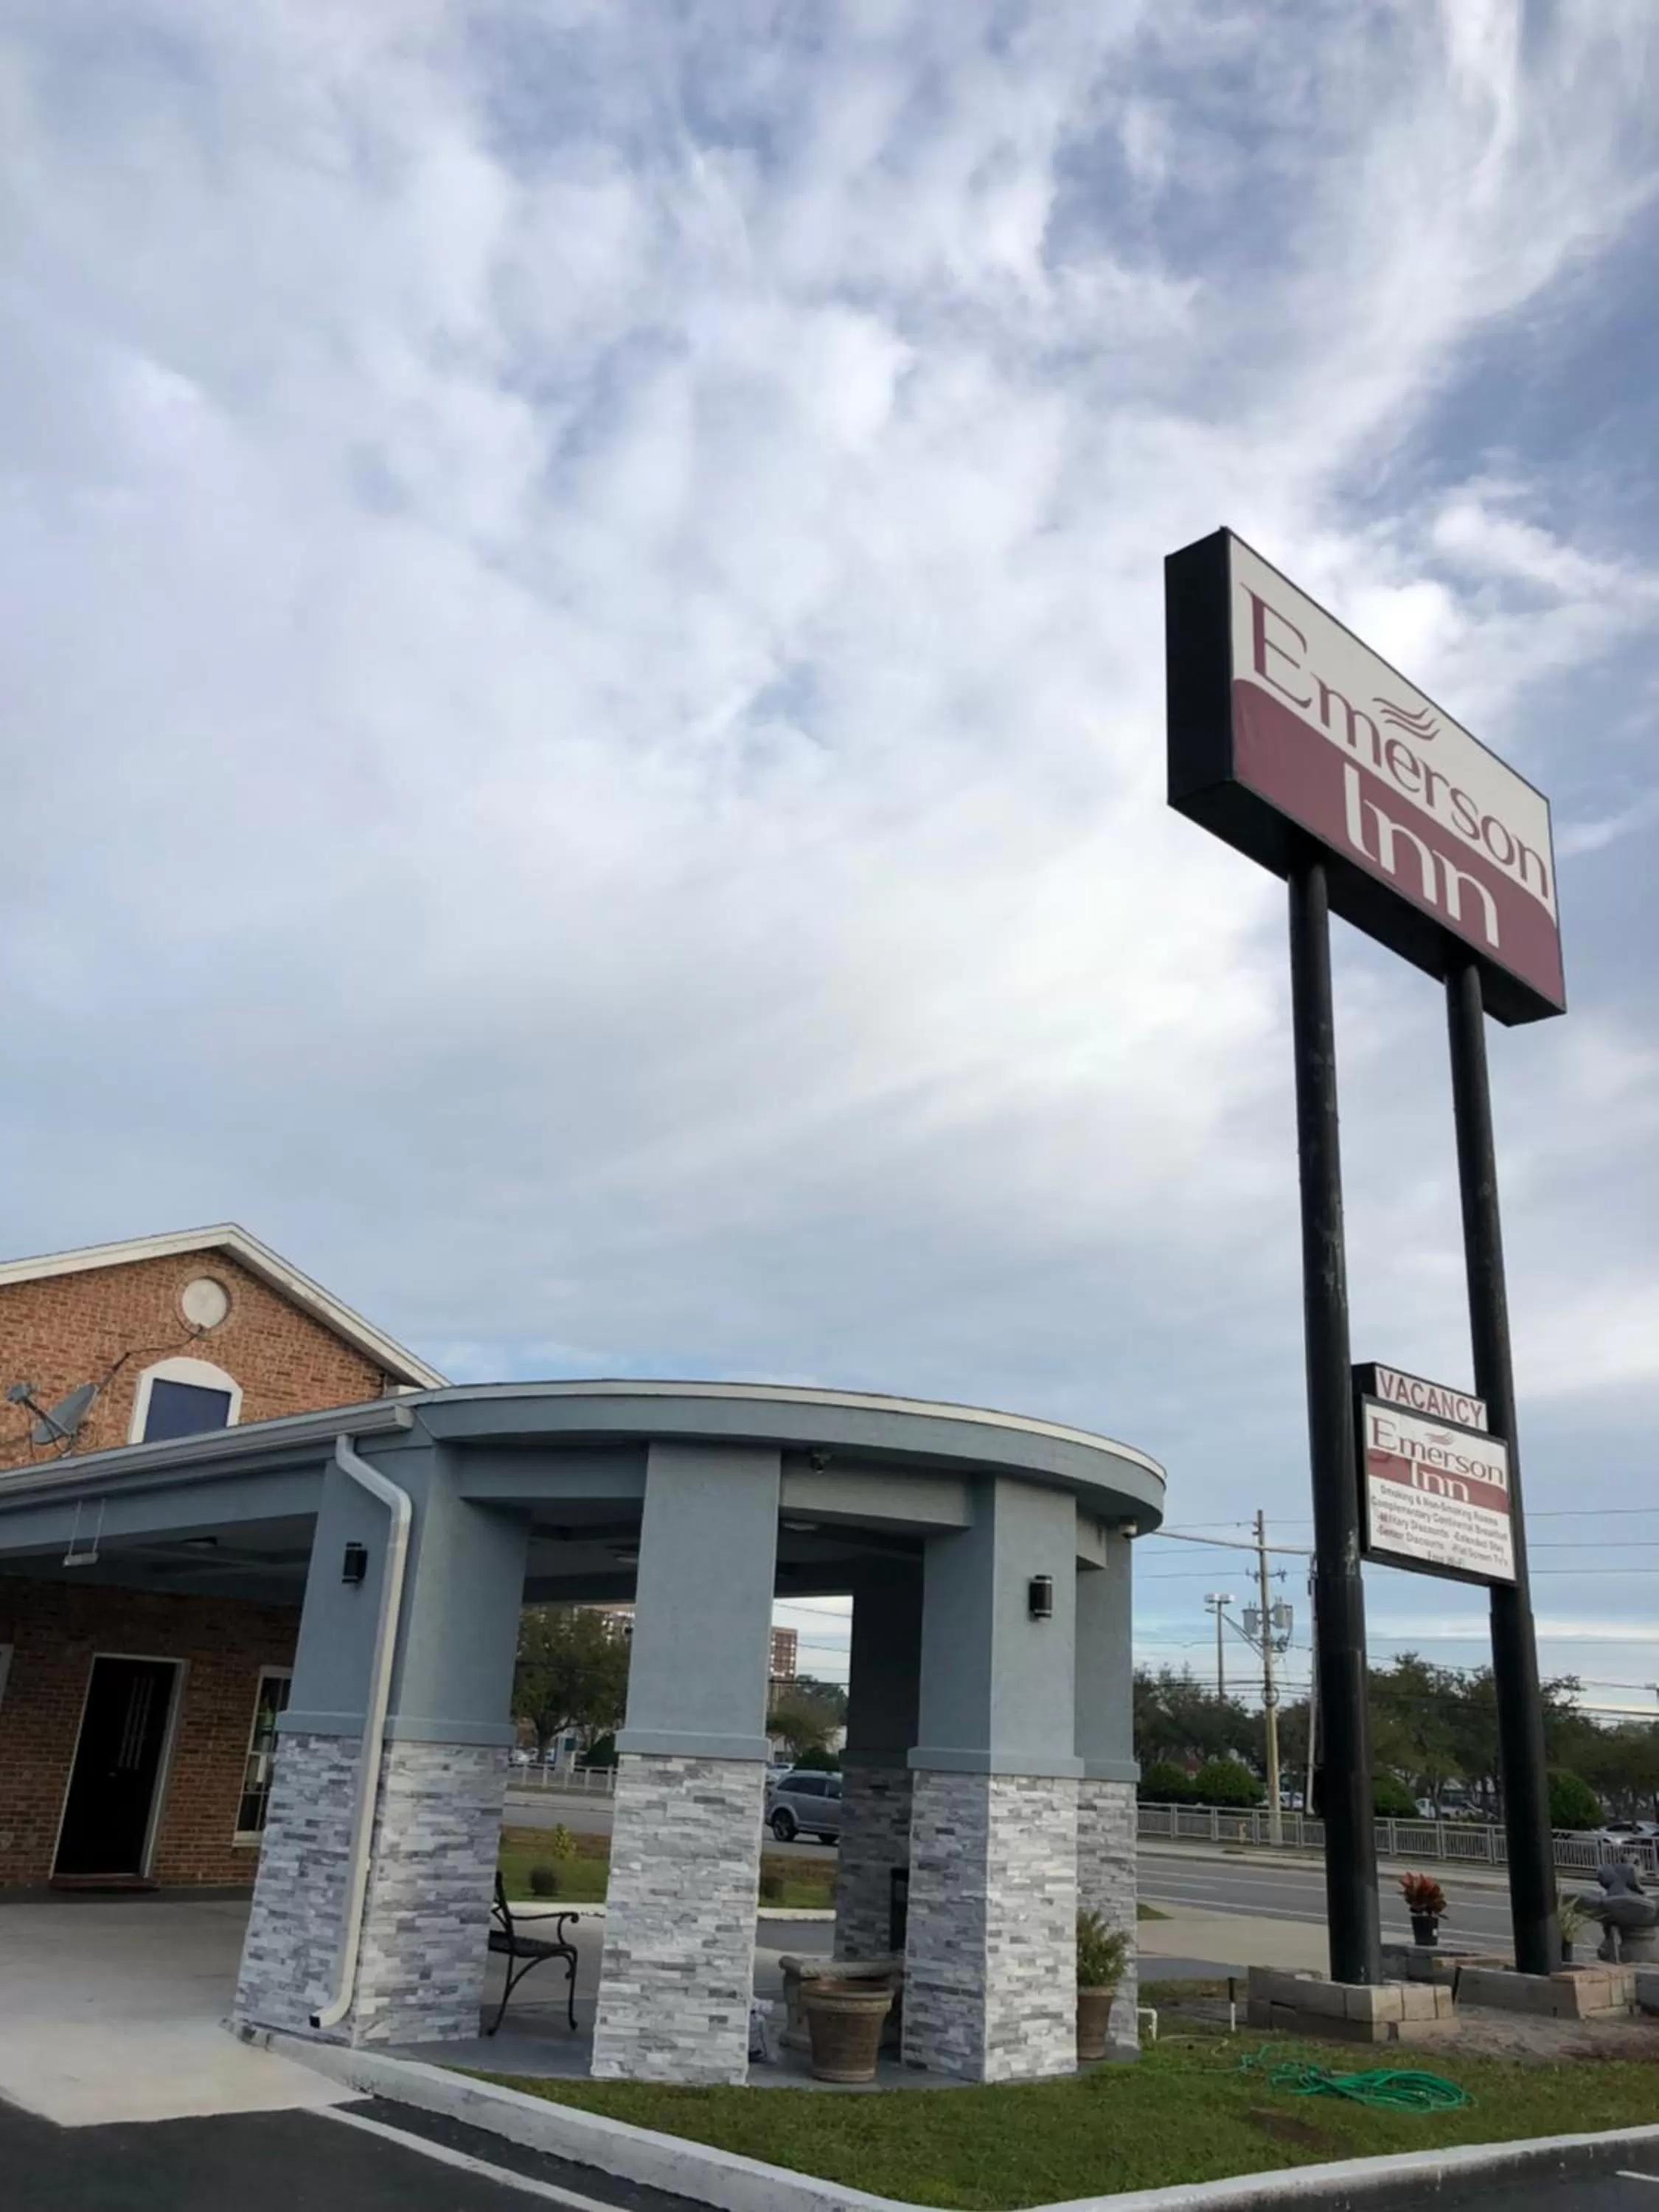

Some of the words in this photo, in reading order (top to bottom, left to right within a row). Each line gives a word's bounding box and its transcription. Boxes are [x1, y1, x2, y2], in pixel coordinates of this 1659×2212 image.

[1239, 582, 1548, 899] Emerson
[1343, 762, 1500, 949] Inn
[1379, 1371, 1483, 1427] VACANCY
[1371, 1416, 1504, 1484] Emerson
[1410, 1460, 1470, 1503] Inn
